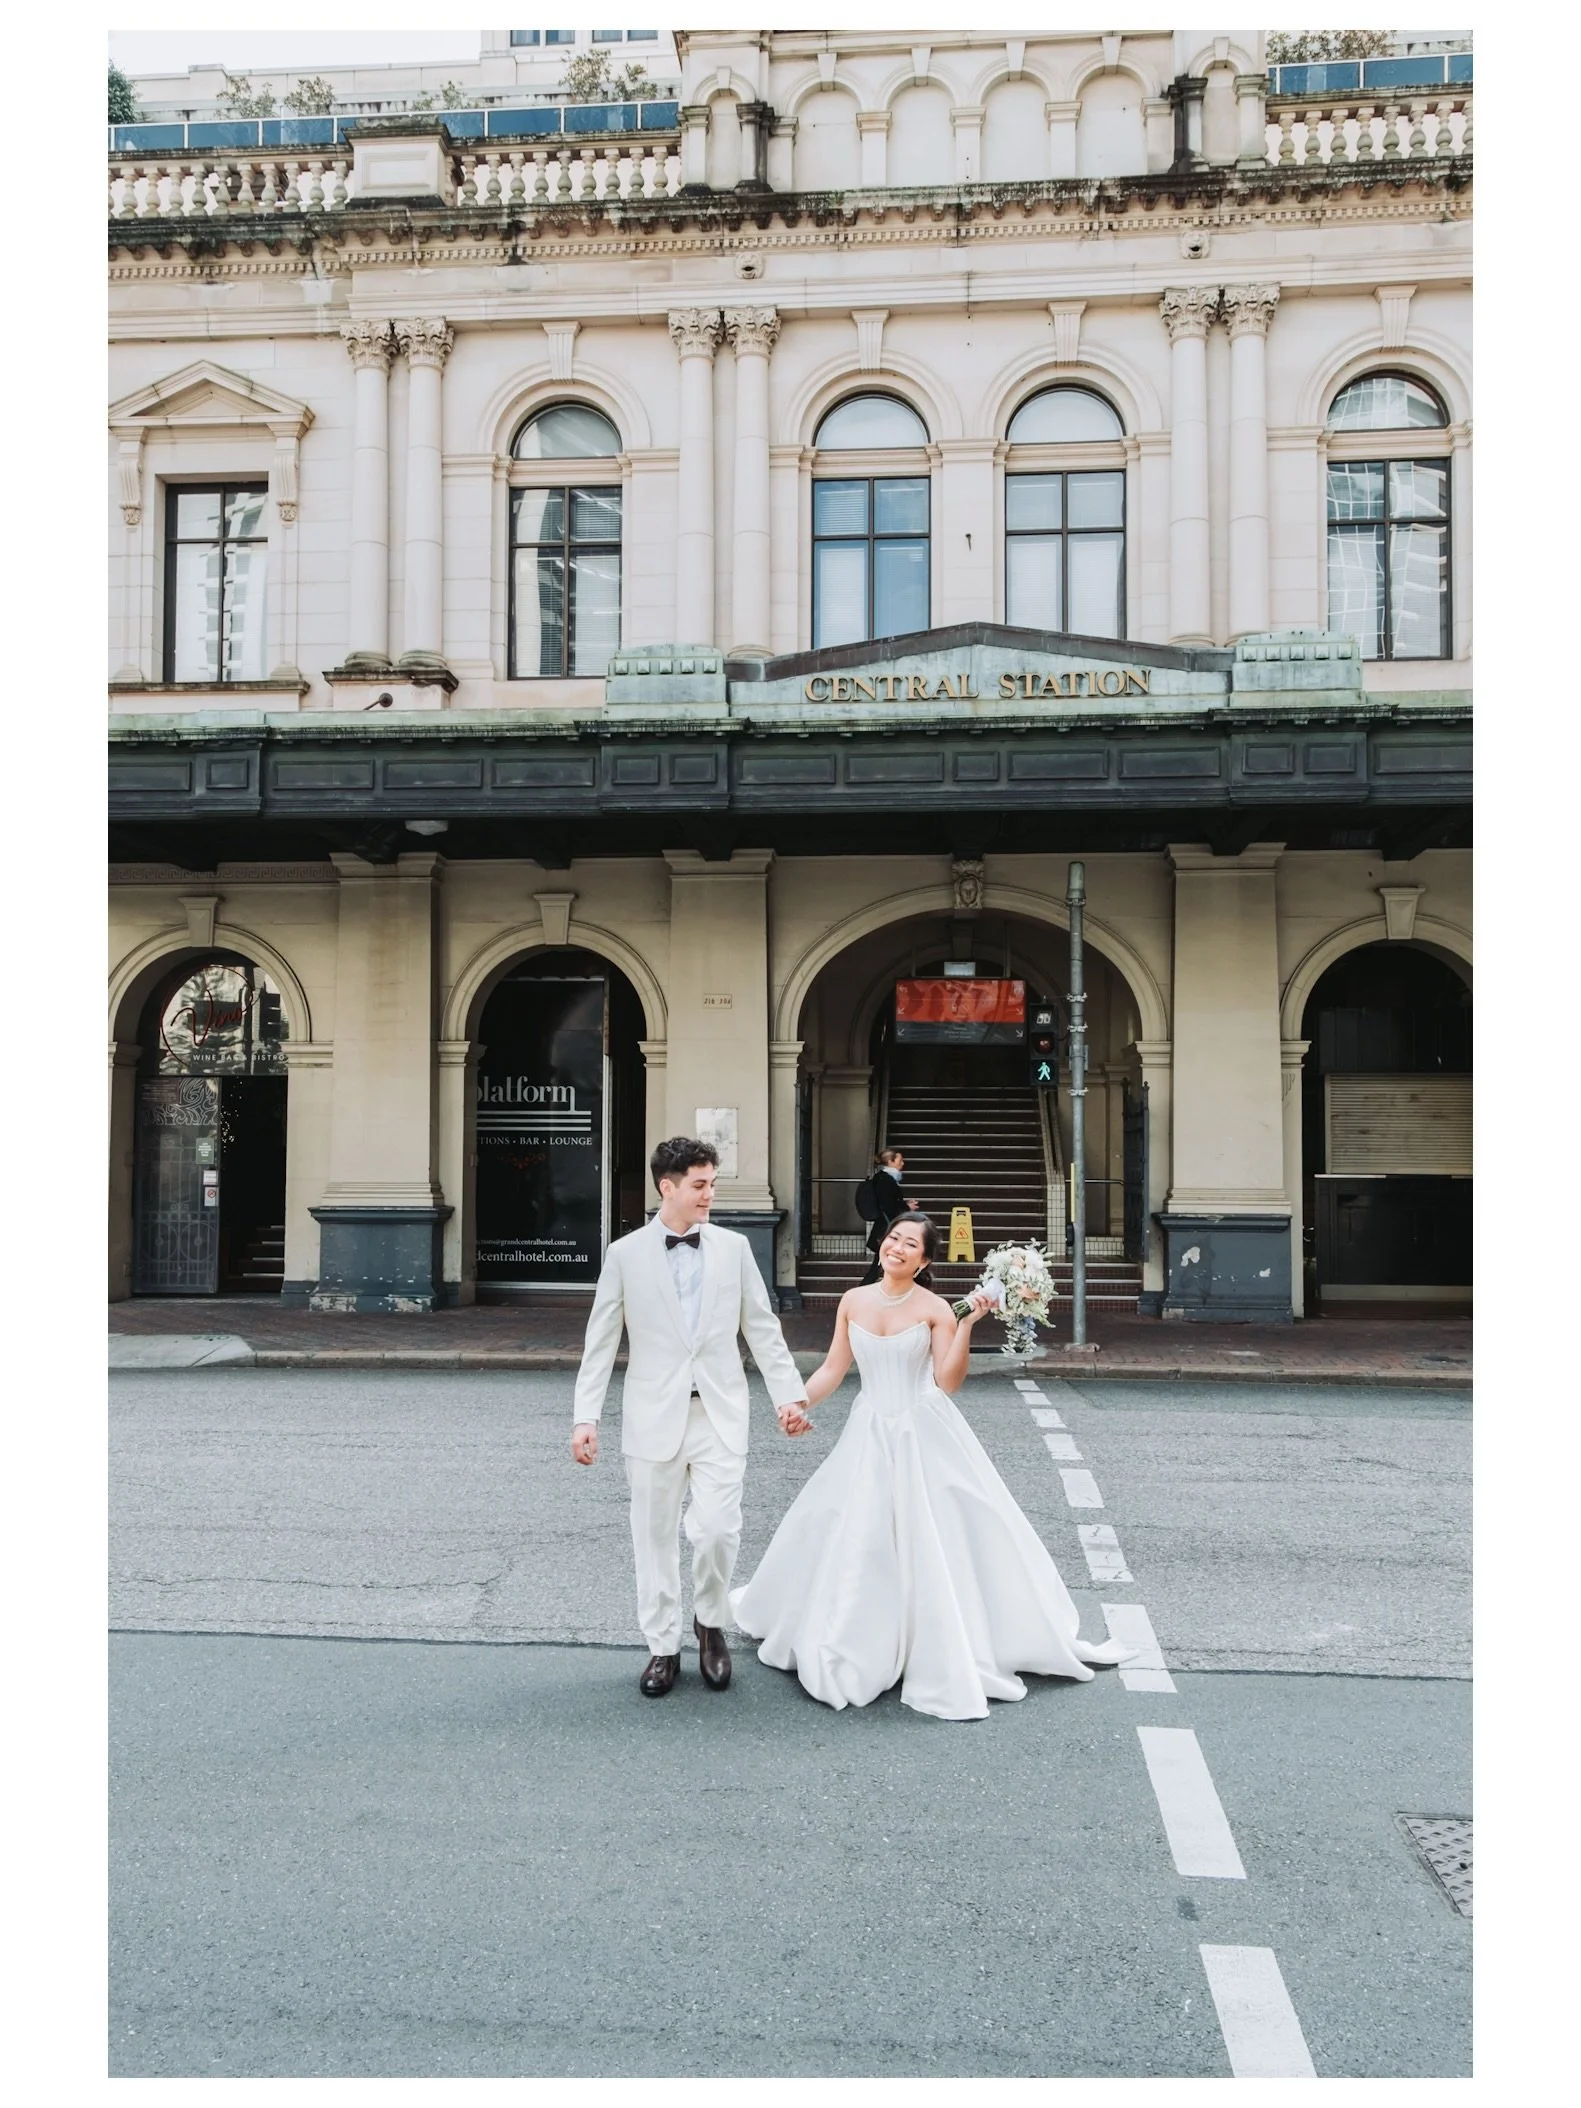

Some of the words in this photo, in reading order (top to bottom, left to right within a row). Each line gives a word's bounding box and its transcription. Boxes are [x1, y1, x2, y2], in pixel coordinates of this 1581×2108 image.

[804, 672, 979, 703] CENTRAL
[998, 669, 1151, 699] STATION
[519, 1136, 540, 1145] BAR
[549, 1136, 593, 1146] LOUNGE
